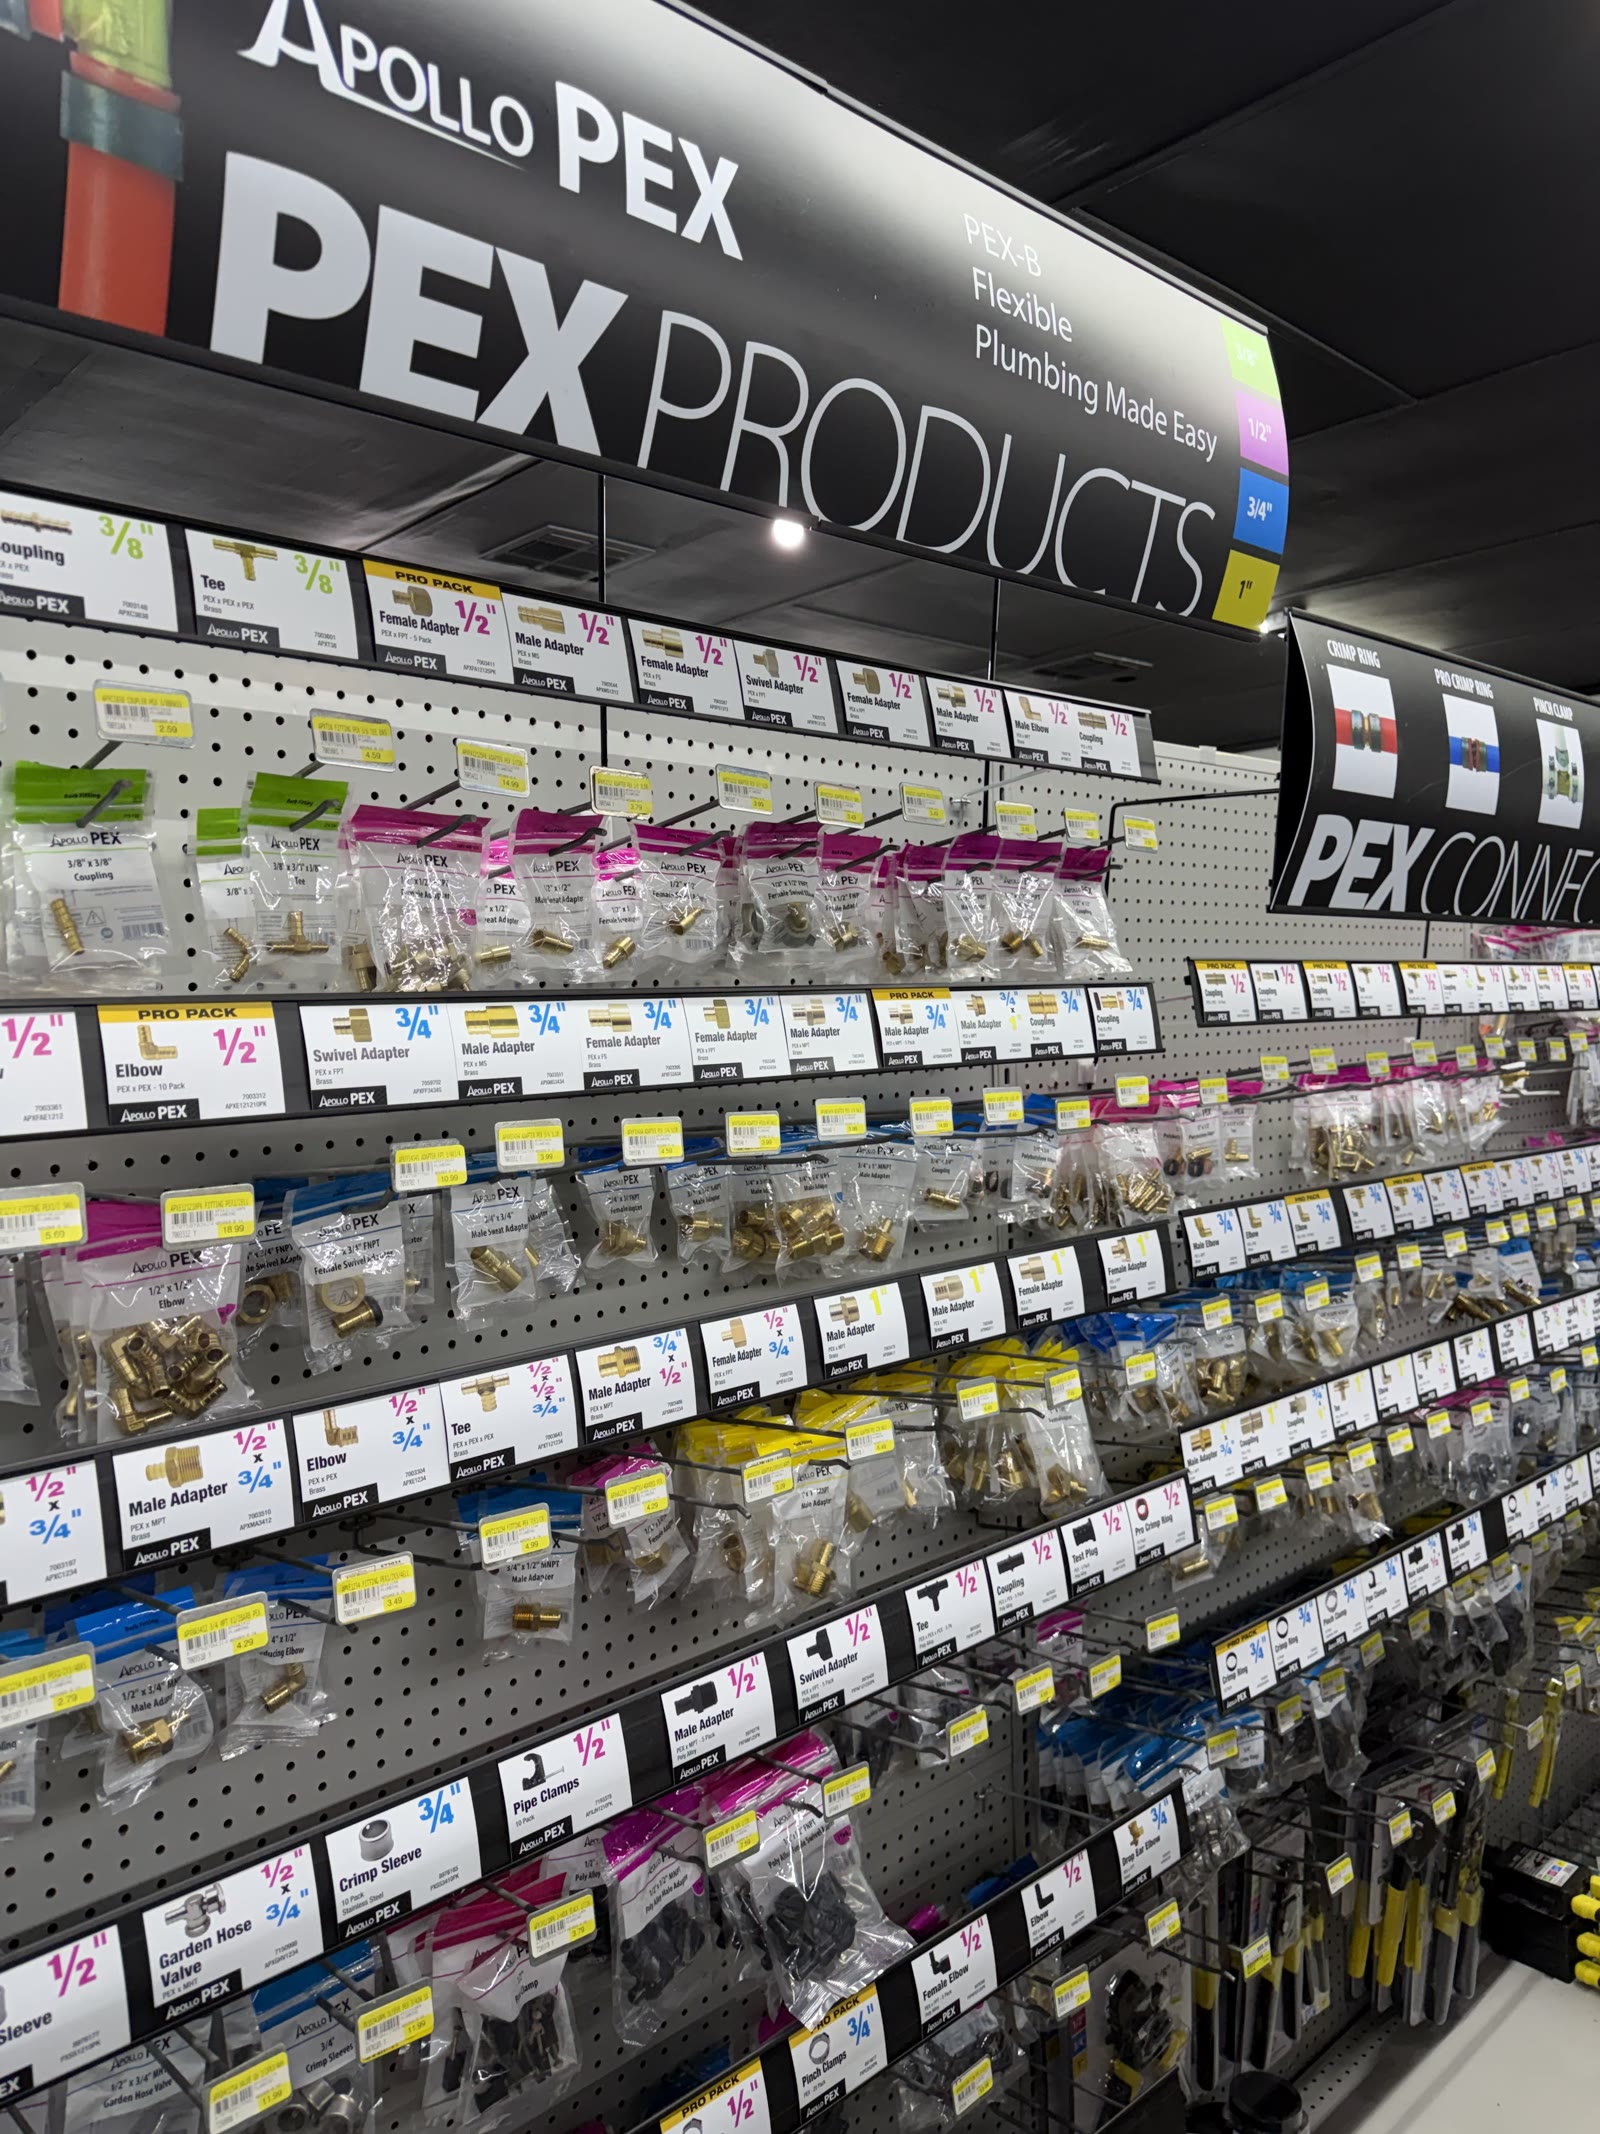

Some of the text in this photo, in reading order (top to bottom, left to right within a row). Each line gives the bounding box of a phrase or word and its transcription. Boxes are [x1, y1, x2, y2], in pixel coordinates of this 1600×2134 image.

[236, 0, 744, 261] APOLLO PEX
[963, 213, 1043, 277] PEX-B
[971, 267, 1072, 342] Flexible
[210, 151, 1216, 617] PEX PRODUCTS
[976, 323, 1218, 463] Plumbing Made Easy
[1247, 417, 1274, 442] 1/2"
[1246, 496, 1274, 521] 3/4"
[98, 515, 154, 559] 3/8"
[0, 542, 65, 566] oupling
[200, 574, 226, 592] Tee
[294, 554, 341, 594] 3/8"
[395, 571, 474, 594] PRO PACK
[1238, 580, 1252, 600] 1"
[379, 611, 460, 637] Female Adapter
[455, 600, 496, 635] 1/2"
[578, 612, 614, 645] 1/2"
[206, 623, 269, 644] APOLLO PEX
[515, 632, 584, 656] Male Adapter
[695, 635, 727, 666] 1/2"
[1327, 639, 1381, 669] CRIMP RING
[641, 656, 709, 678] Female Adapter
[793, 654, 821, 683] 1/2"
[746, 675, 804, 695] Swivel Adapter
[1434, 668, 1494, 699] PRO CRIMP RING
[365, 751, 382, 760] 4.59
[502, 779, 520, 789] 14.99
[50, 831, 122, 847] APOLLO PEX
[66, 859, 86, 869] 3/8"
[94, 857, 112, 868] 3/8"
[73, 870, 114, 882] Coupling
[1287, 814, 1436, 912] PEX
[911, 991, 934, 999] PACK
[138, 1008, 238, 1020] PRO PACK
[395, 1005, 439, 1040] 3/4"
[528, 1002, 566, 1035] 3/4"
[643, 999, 677, 1030] 3/4"
[925, 1003, 950, 1030] 3/4"
[2, 1014, 64, 1059] 1/2"
[586, 1035, 661, 1048] Female Adapter
[884, 1026, 929, 1036] Male Adapter
[213, 1025, 266, 1066] 1/2"
[313, 1046, 410, 1062] Swivel Adapter
[461, 1041, 535, 1055] Male Adapter
[115, 1063, 163, 1078] Elbow
[117, 1085, 130, 1093] PEX
[138, 1084, 152, 1092] PEX
[159, 1083, 167, 1091] 10
[169, 1082, 185, 1090] Pack
[120, 1104, 188, 1122] APOLLO PEX
[440, 1174, 459, 1183] 10.99
[222, 1224, 245, 1234] 18.99
[869, 1288, 887, 1315] 1"
[653, 1330, 682, 1354] 3/4"
[826, 1322, 875, 1342] Male Adapter
[668, 1354, 675, 1362] x
[659, 1361, 688, 1386] 1/2"
[389, 1387, 426, 1417] 1/2"
[588, 1377, 651, 1400] Male Adapter
[233, 1422, 276, 1454] 1/2"
[392, 1423, 430, 1452] 3/4"
[451, 1421, 471, 1436] Tee
[254, 1453, 263, 1463] x
[306, 1452, 347, 1472] Elbow
[25, 1466, 76, 1502] 1/2"
[238, 1461, 281, 1493] 3/4"
[48, 1500, 60, 1511] x
[129, 1482, 228, 1517] Male Adapter
[29, 1508, 82, 1544] 3/4"
[130, 1522, 143, 1532] PEX
[151, 1517, 166, 1527] MPT
[131, 1532, 151, 1542] Brass
[133, 1536, 200, 1566] APOLLO PEX
[523, 1542, 539, 1552] 4.99
[1032, 1531, 1054, 1565] 1/2"
[955, 1562, 980, 1597] 1/2"
[996, 1576, 1024, 1595] Coupling
[387, 1597, 403, 1607] 3.49
[845, 1608, 872, 1647] 1/2"
[917, 1619, 929, 1632] Tee
[236, 1638, 255, 1649] 4.29
[728, 1656, 759, 1699] 1/2"
[800, 1652, 858, 1685] Swivel Adapter
[57, 1694, 78, 1705] 2.79
[674, 1707, 734, 1742] Male Adapter
[573, 1718, 611, 1767] 1/2"
[418, 1782, 461, 1834] 3/4"
[513, 1776, 580, 1815] Pipe Clamps
[261, 1849, 303, 1887] 1/2"
[339, 1846, 423, 1893] Crimp Sleeve
[266, 1888, 309, 1927] 3/4"
[159, 1918, 252, 1970] Garden Hose
[960, 1918, 984, 1958] 1/2"
[47, 1931, 107, 1997] 1/2"
[161, 1960, 202, 1988] Valve
[923, 1964, 969, 2001] Female Elbow
[847, 2003, 875, 2046] 3/4"
[802, 2051, 847, 2087] Pinch Clamps
[681, 2074, 740, 2118] PRO PACK
[727, 2079, 758, 2128] 1/2"
